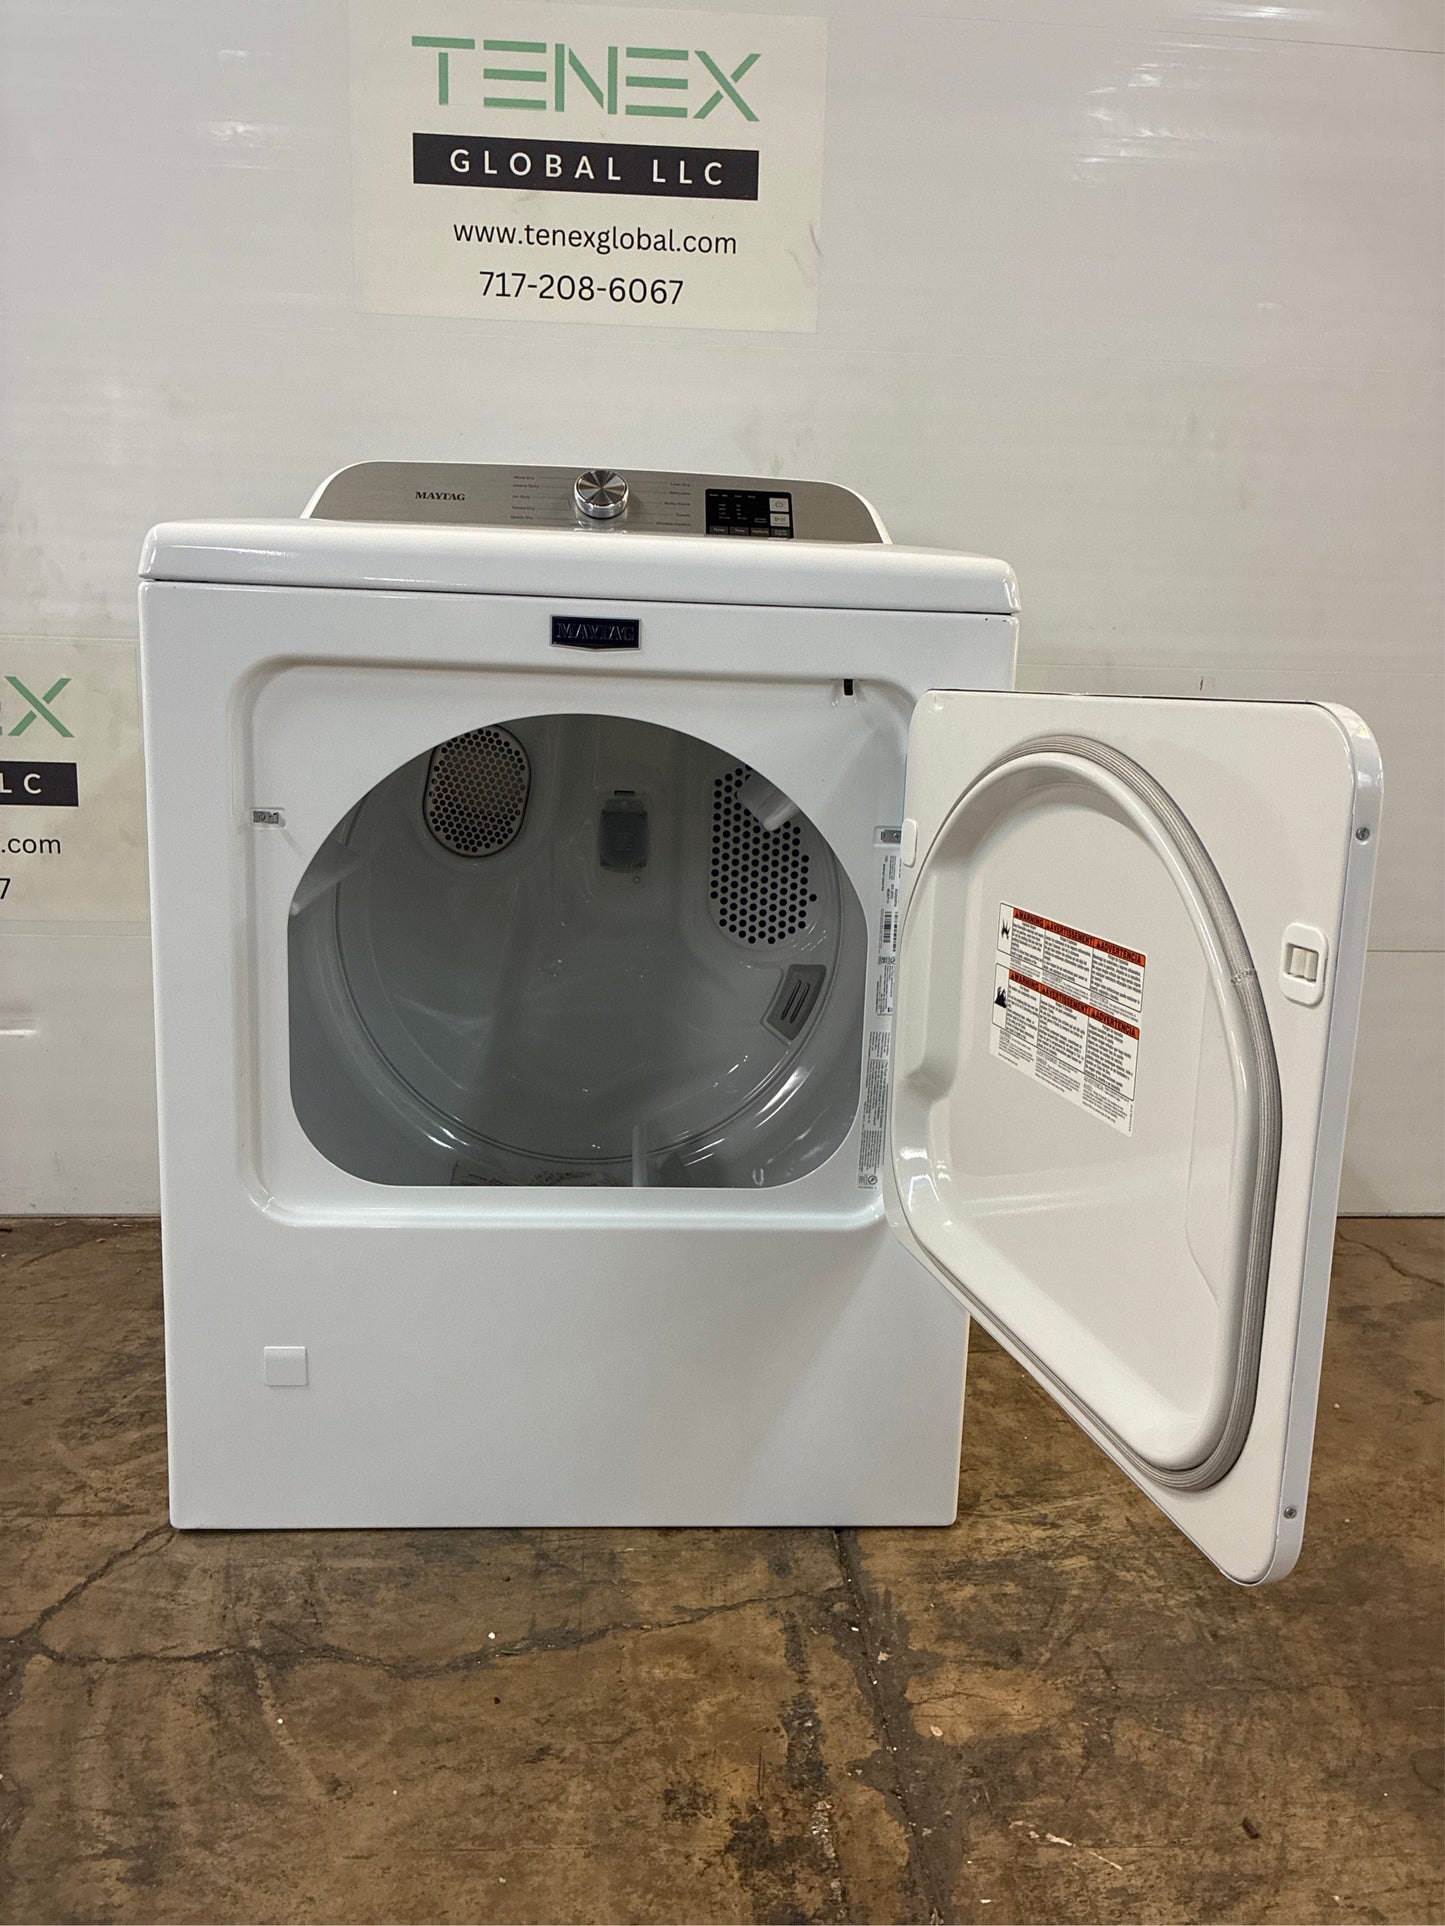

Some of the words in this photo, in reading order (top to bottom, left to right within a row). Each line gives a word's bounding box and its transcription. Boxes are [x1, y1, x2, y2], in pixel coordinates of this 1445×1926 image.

[412, 35, 762, 122] TENEX
[450, 148, 621, 181] GLOBAL
[652, 159, 723, 186] LLC
[453, 222, 736, 255] www.tenexglobal.com
[479, 271, 684, 305] 717-208-6067
[415, 491, 465, 501] MAYTAG
[556, 622, 635, 641] MAYTAG
[0, 676, 75, 737] X
[0, 877, 11, 900] 7
[1101, 941, 1142, 963] ADVERTENCIA
